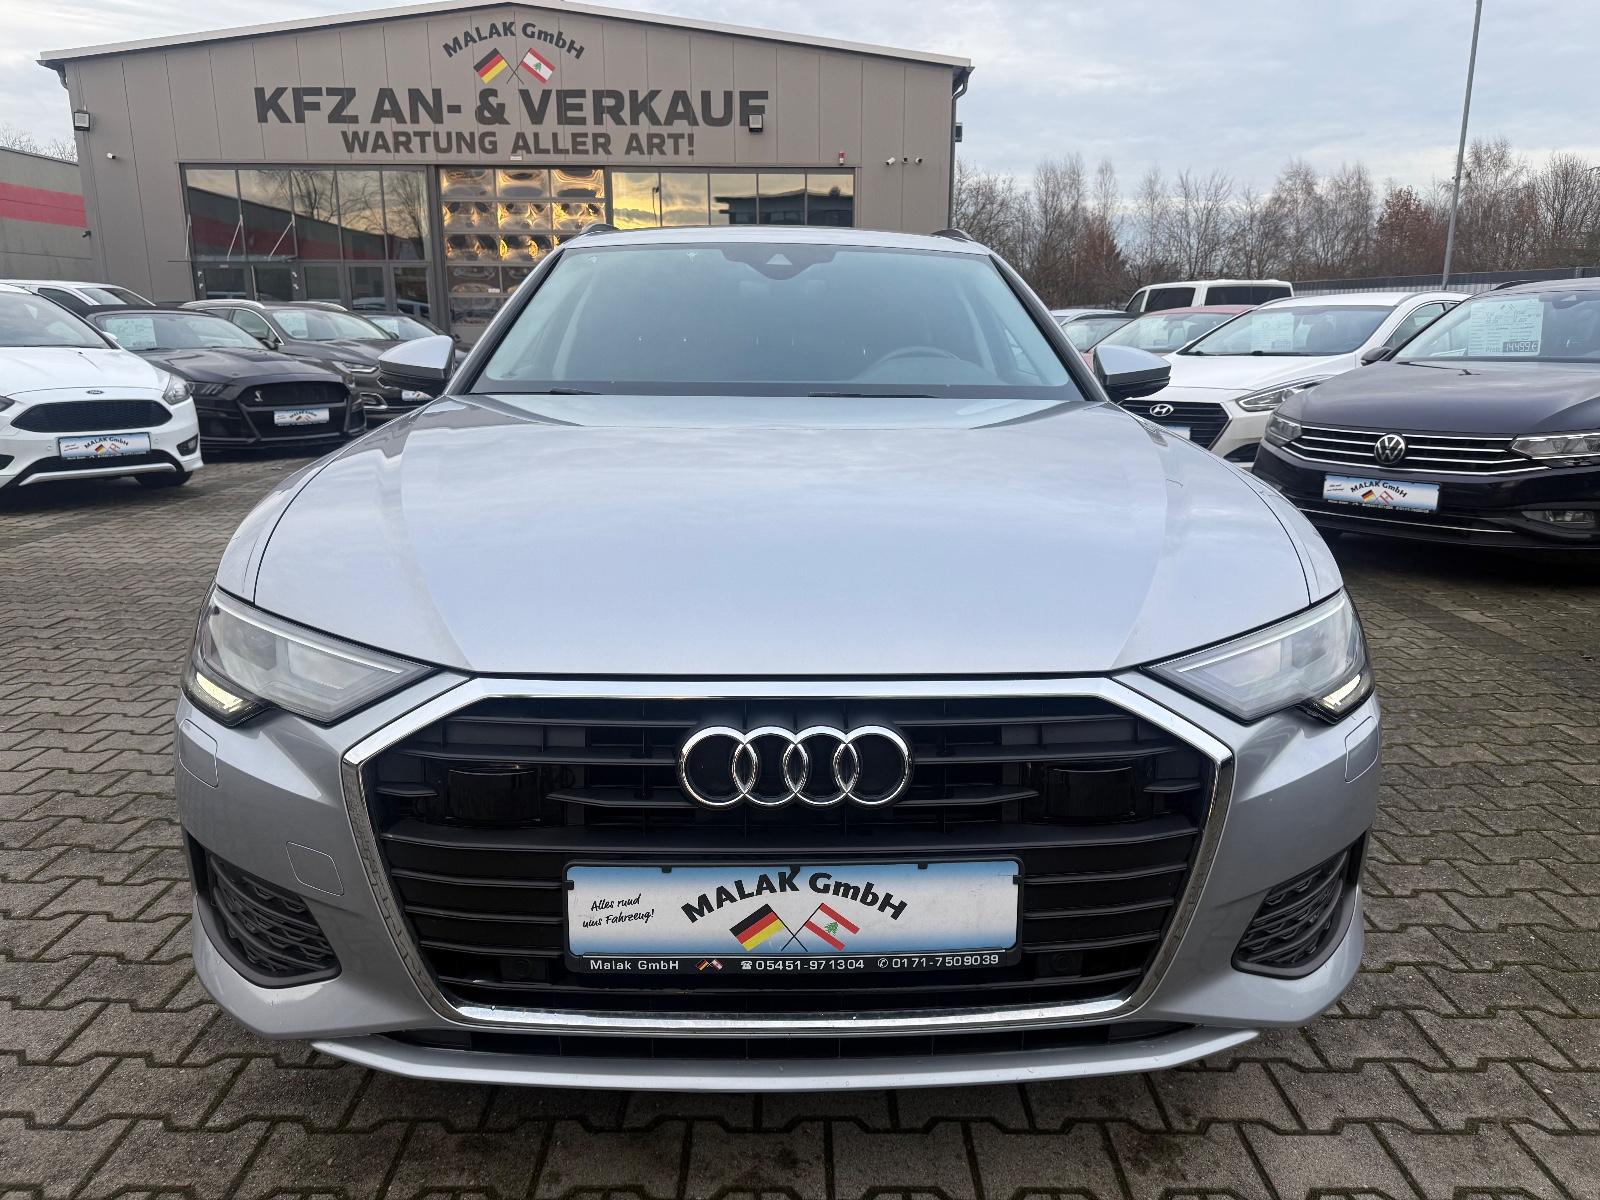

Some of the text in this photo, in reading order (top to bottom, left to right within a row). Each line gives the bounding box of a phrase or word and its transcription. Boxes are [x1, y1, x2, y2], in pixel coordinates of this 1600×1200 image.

[442, 21, 585, 60] MALAK GmbH
[254, 86, 769, 127] KFZ AN- & VERKAUF
[341, 130, 695, 156] WARTUNG ALLER ART!
[84, 436, 108, 449] MALAK
[1350, 480, 1380, 493] MALAK
[1382, 482, 1408, 498] GmbH
[590, 893, 642, 912] Alles rund
[680, 868, 908, 924] MALAK GmbH
[605, 908, 655, 925] Fahrzeug!
[590, 954, 999, 971] Malak GmbH 05451-971304 0171-7509039
